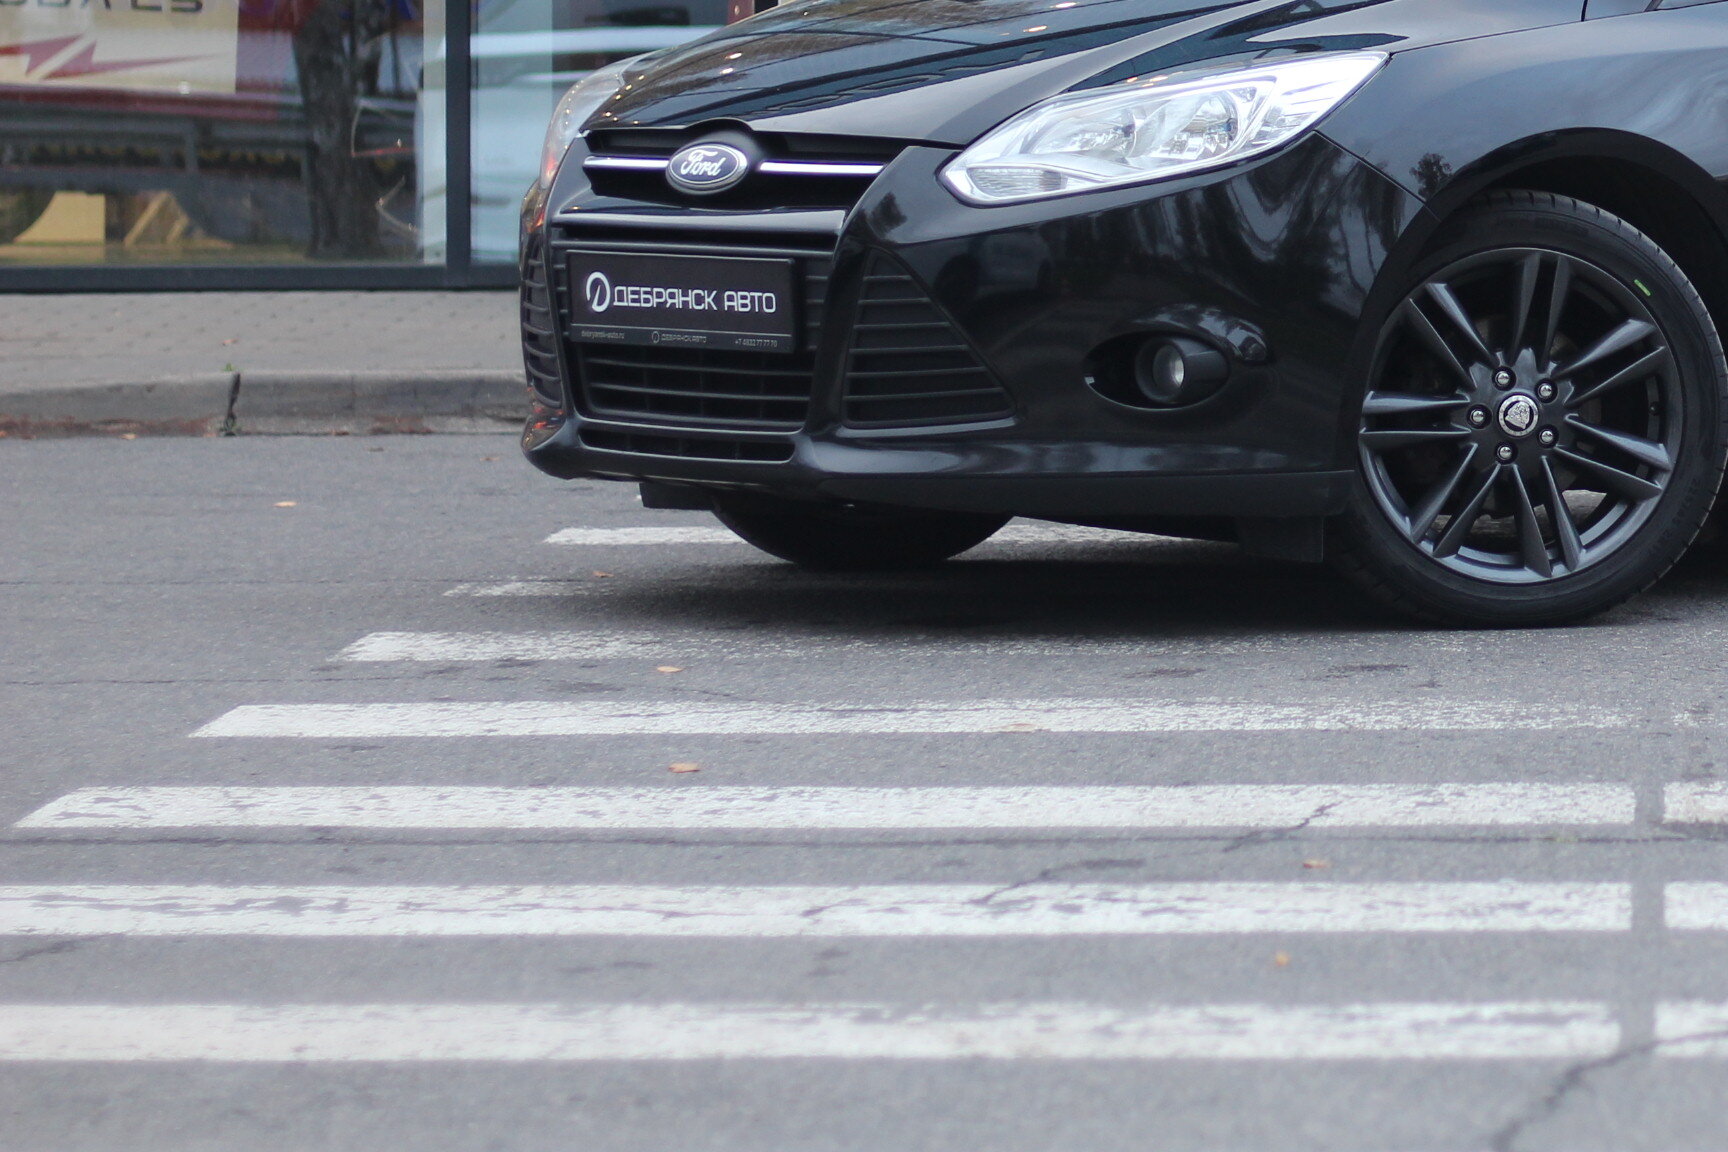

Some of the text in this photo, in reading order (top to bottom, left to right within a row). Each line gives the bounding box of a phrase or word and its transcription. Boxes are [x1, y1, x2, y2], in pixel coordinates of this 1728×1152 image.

[680, 149, 726, 176] Ford
[613, 286, 776, 314] ДЕБРЯНСК АВТО
